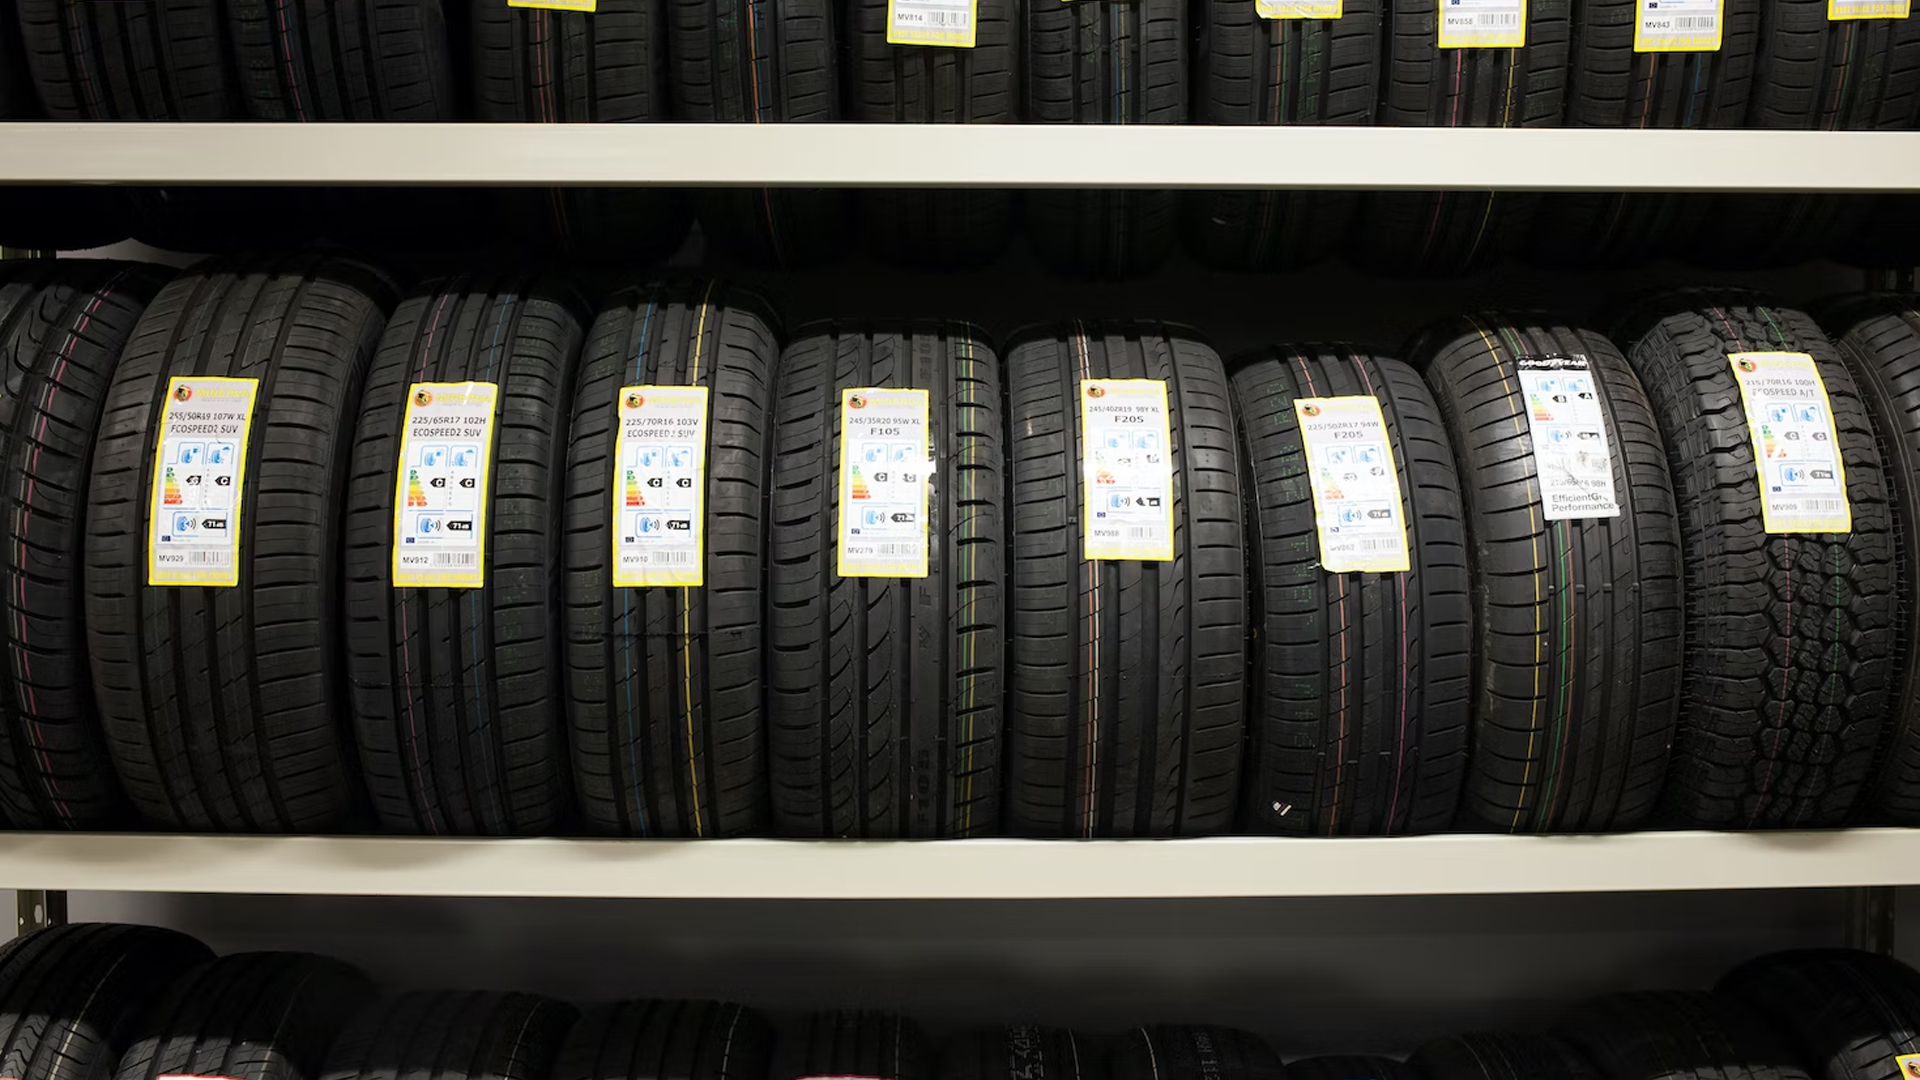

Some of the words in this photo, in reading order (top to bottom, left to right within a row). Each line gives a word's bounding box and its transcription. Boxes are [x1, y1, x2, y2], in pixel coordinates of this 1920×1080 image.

[897, 13, 923, 21] MV814
[1645, 21, 1671, 29] MV843
[1518, 359, 1588, 367] GOODYEAR
[212, 413, 236, 421] 107W
[236, 413, 246, 421] XL
[412, 416, 461, 425] 225/65R17
[849, 416, 892, 424] 245/35R20
[892, 417, 911, 425] 95W
[1114, 415, 1145, 423] F205
[625, 418, 675, 426] 225/70R16
[676, 418, 699, 426] 103V
[220, 425, 239, 433] SUV
[412, 428, 462, 437] ECOSPEED2
[463, 429, 482, 437] SUV
[870, 427, 901, 436] F105
[1333, 431, 1364, 439] F205
[1551, 503, 1614, 512] Performance
[158, 554, 184, 562] MV929
[402, 556, 429, 564] MV912
[622, 555, 649, 564] MV910
